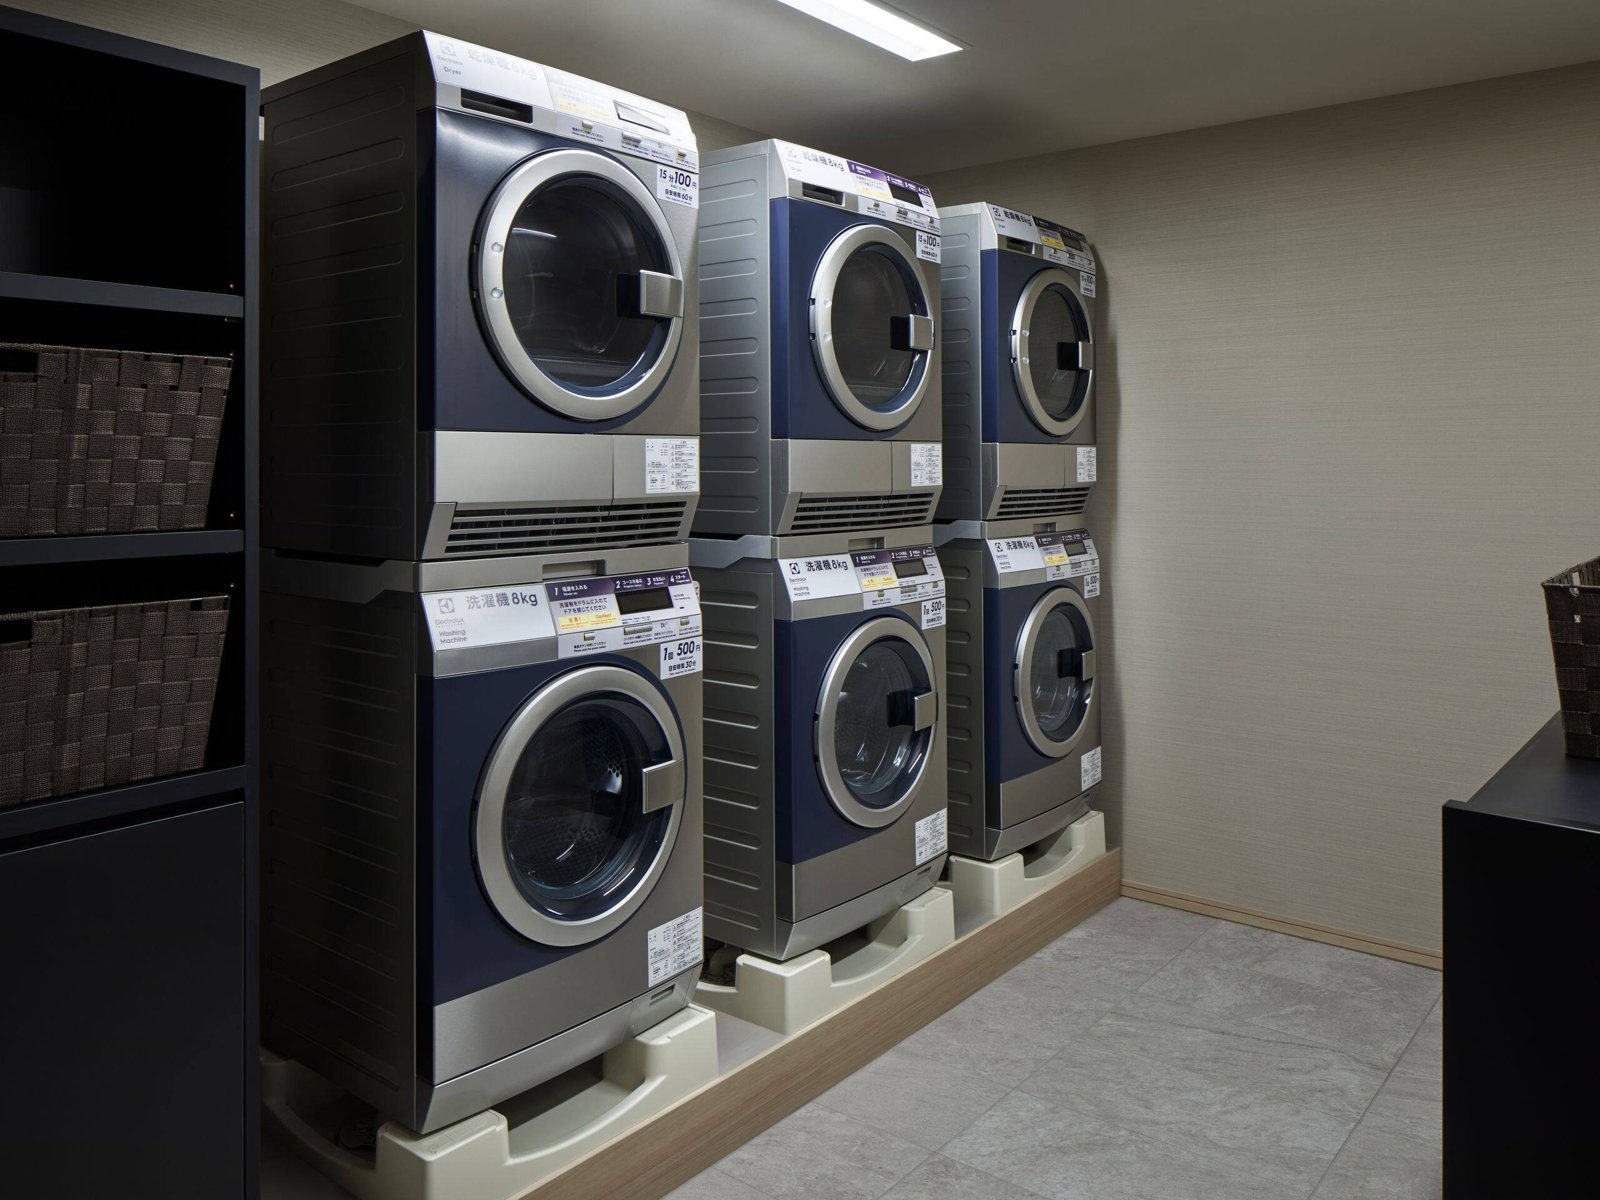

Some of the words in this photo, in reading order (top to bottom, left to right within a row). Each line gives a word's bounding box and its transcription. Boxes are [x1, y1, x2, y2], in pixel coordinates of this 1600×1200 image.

[443, 66, 462, 75] Dryer
[805, 559, 848, 572] 洗濯機8kg
[647, 577, 651, 586] 3
[670, 574, 675, 583] 4
[615, 580, 620, 589] 2
[554, 587, 558, 596] 1
[465, 592, 538, 609] 洗濯機8kg
[439, 629, 466, 638] Washing
[440, 635, 467, 644] Machine
